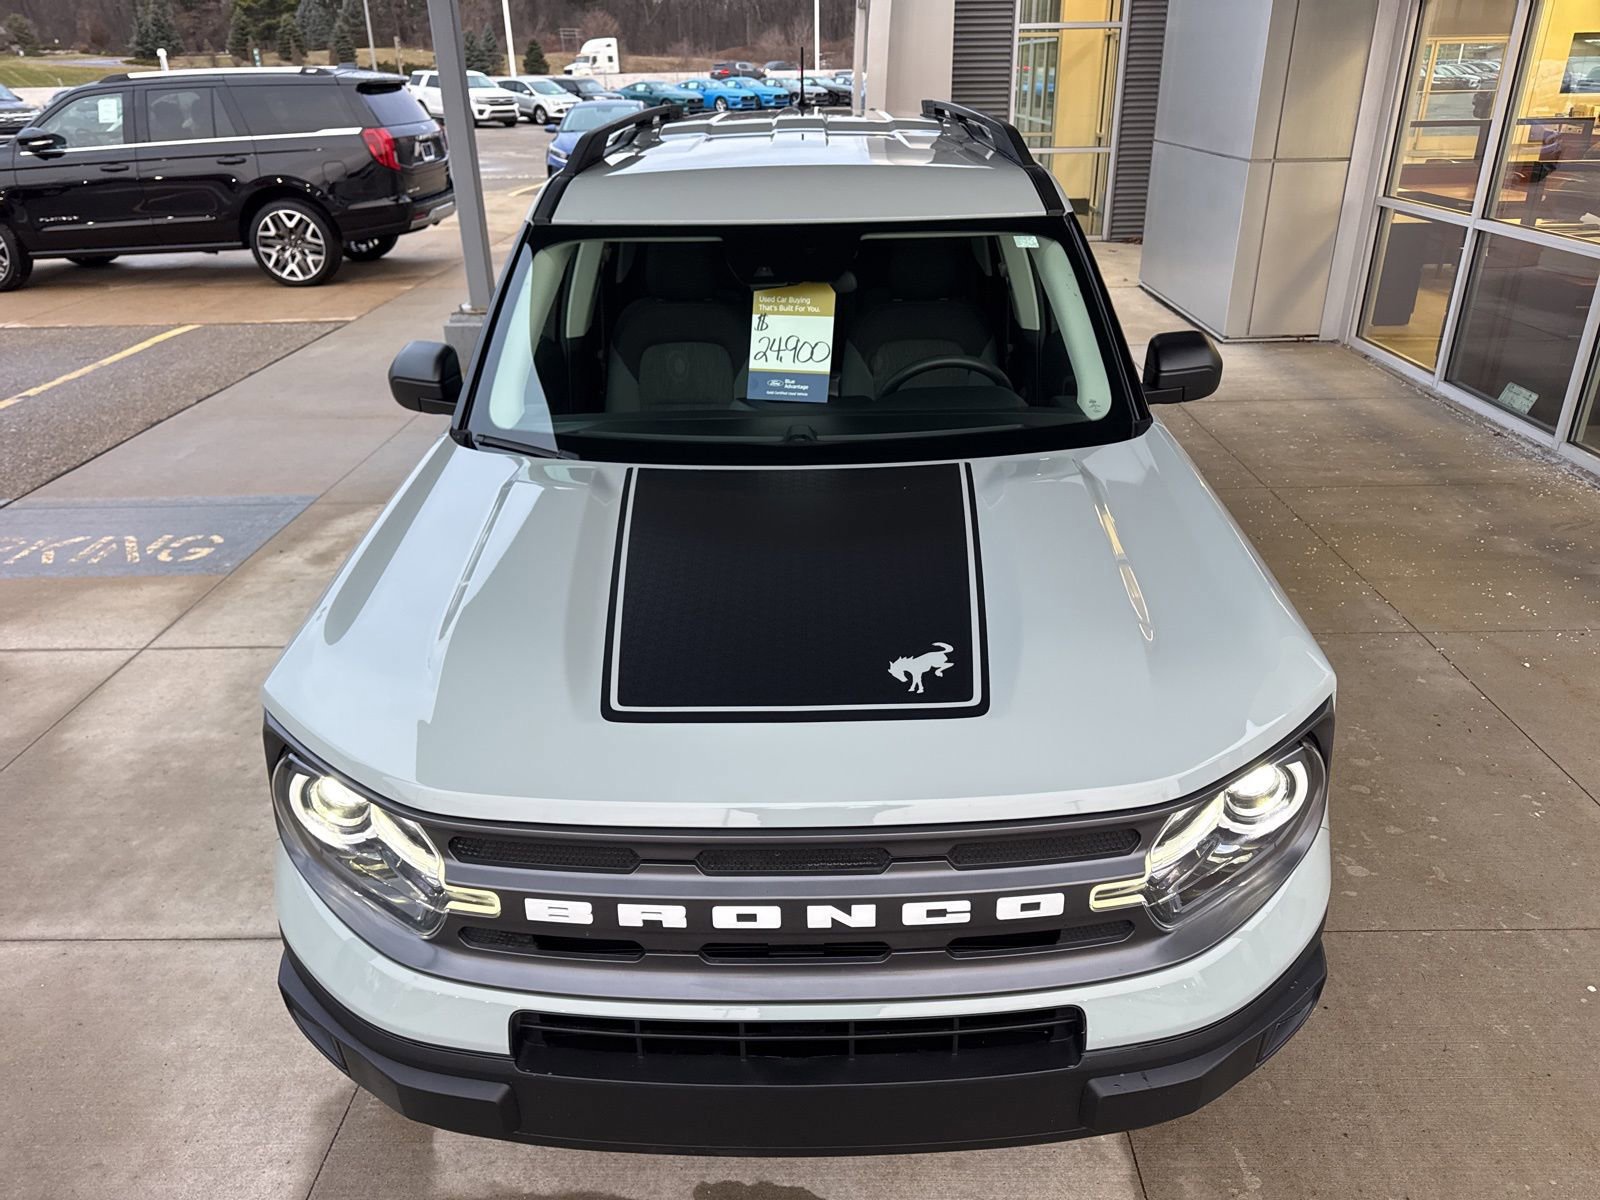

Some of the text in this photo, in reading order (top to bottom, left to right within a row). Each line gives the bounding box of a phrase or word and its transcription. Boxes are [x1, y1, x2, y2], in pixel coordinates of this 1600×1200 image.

[789, 297, 811, 305] Buying
[754, 313, 769, 332] $
[754, 335, 831, 364] 24,900
[525, 892, 1065, 929] BRONCO
